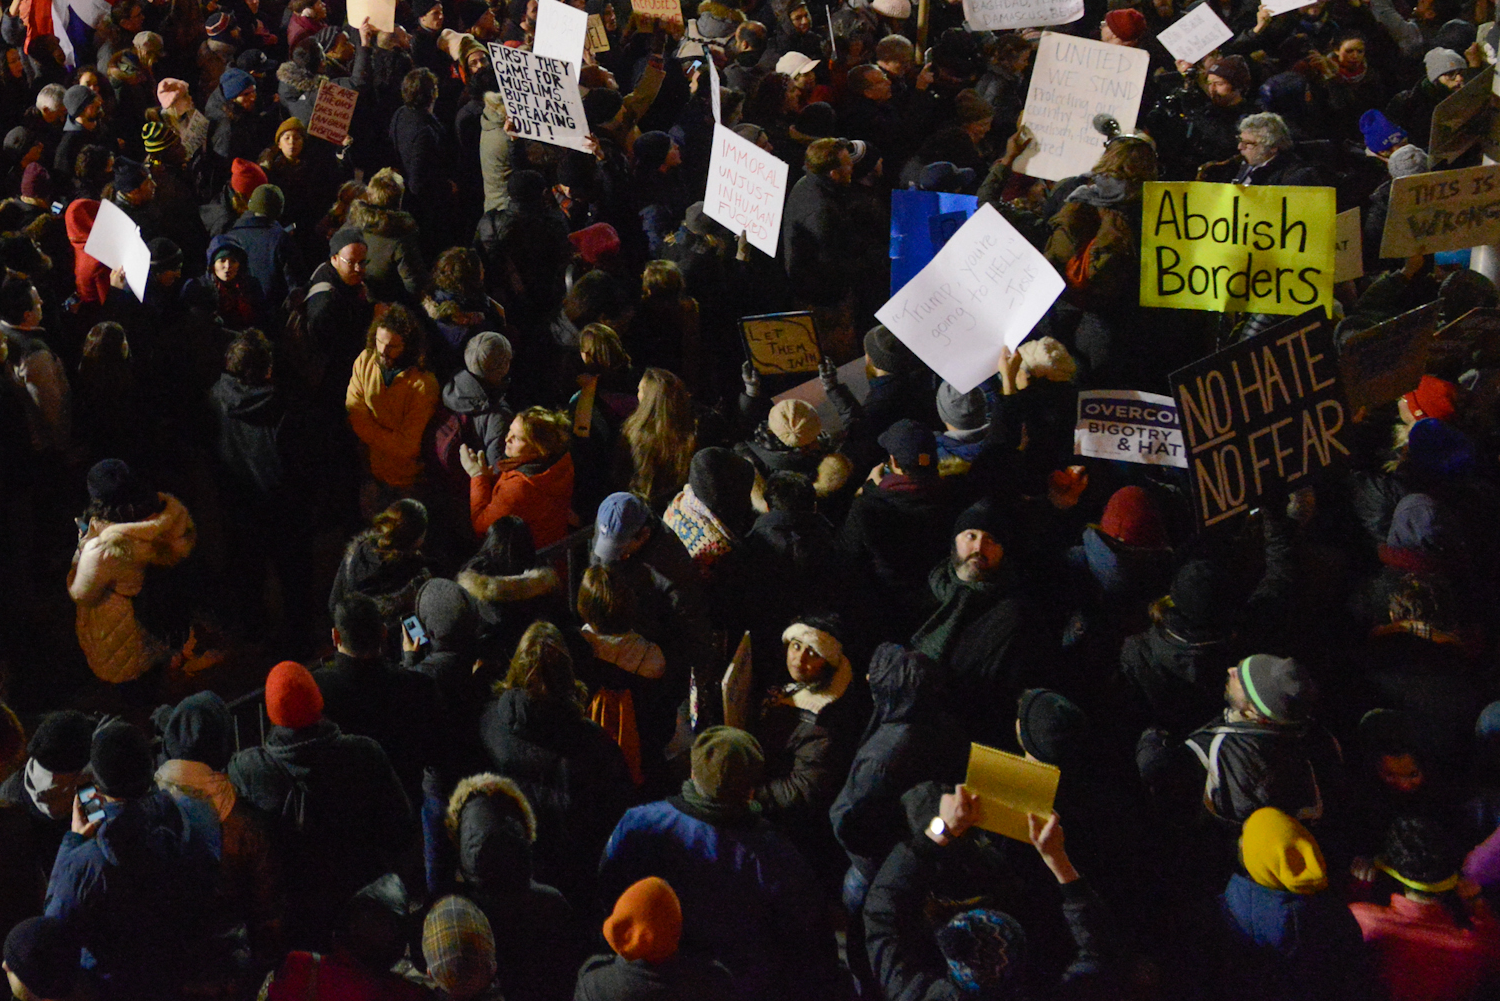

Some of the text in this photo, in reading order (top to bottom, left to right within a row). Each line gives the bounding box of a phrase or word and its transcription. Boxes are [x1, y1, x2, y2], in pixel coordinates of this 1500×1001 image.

[490, 44, 570, 76] FIRST THEY
[1055, 43, 1132, 73] UNITED
[495, 61, 563, 89] CAME FOR
[1048, 68, 1139, 101] WE STAND
[504, 88, 569, 116] BUT I AM
[508, 102, 576, 129] SPEAKING
[722, 139, 780, 189] IMMORAL
[718, 165, 774, 205] UNJUST
[1409, 174, 1494, 205] THIS IS
[717, 200, 768, 240] FUCKED
[718, 184, 775, 227] INHUMAN
[1155, 189, 1308, 253] Abolish
[1155, 245, 1322, 306] Borders
[931, 306, 977, 347] going
[970, 285, 988, 304] to
[748, 326, 784, 341] LET
[768, 342, 807, 355] THEM
[1179, 321, 1337, 447] NO HATE
[1087, 422, 1172, 442] BIGOTRY
[1117, 437, 1132, 452] &
[1138, 440, 1183, 458] HAT
[1194, 398, 1351, 521] NO FEAR
